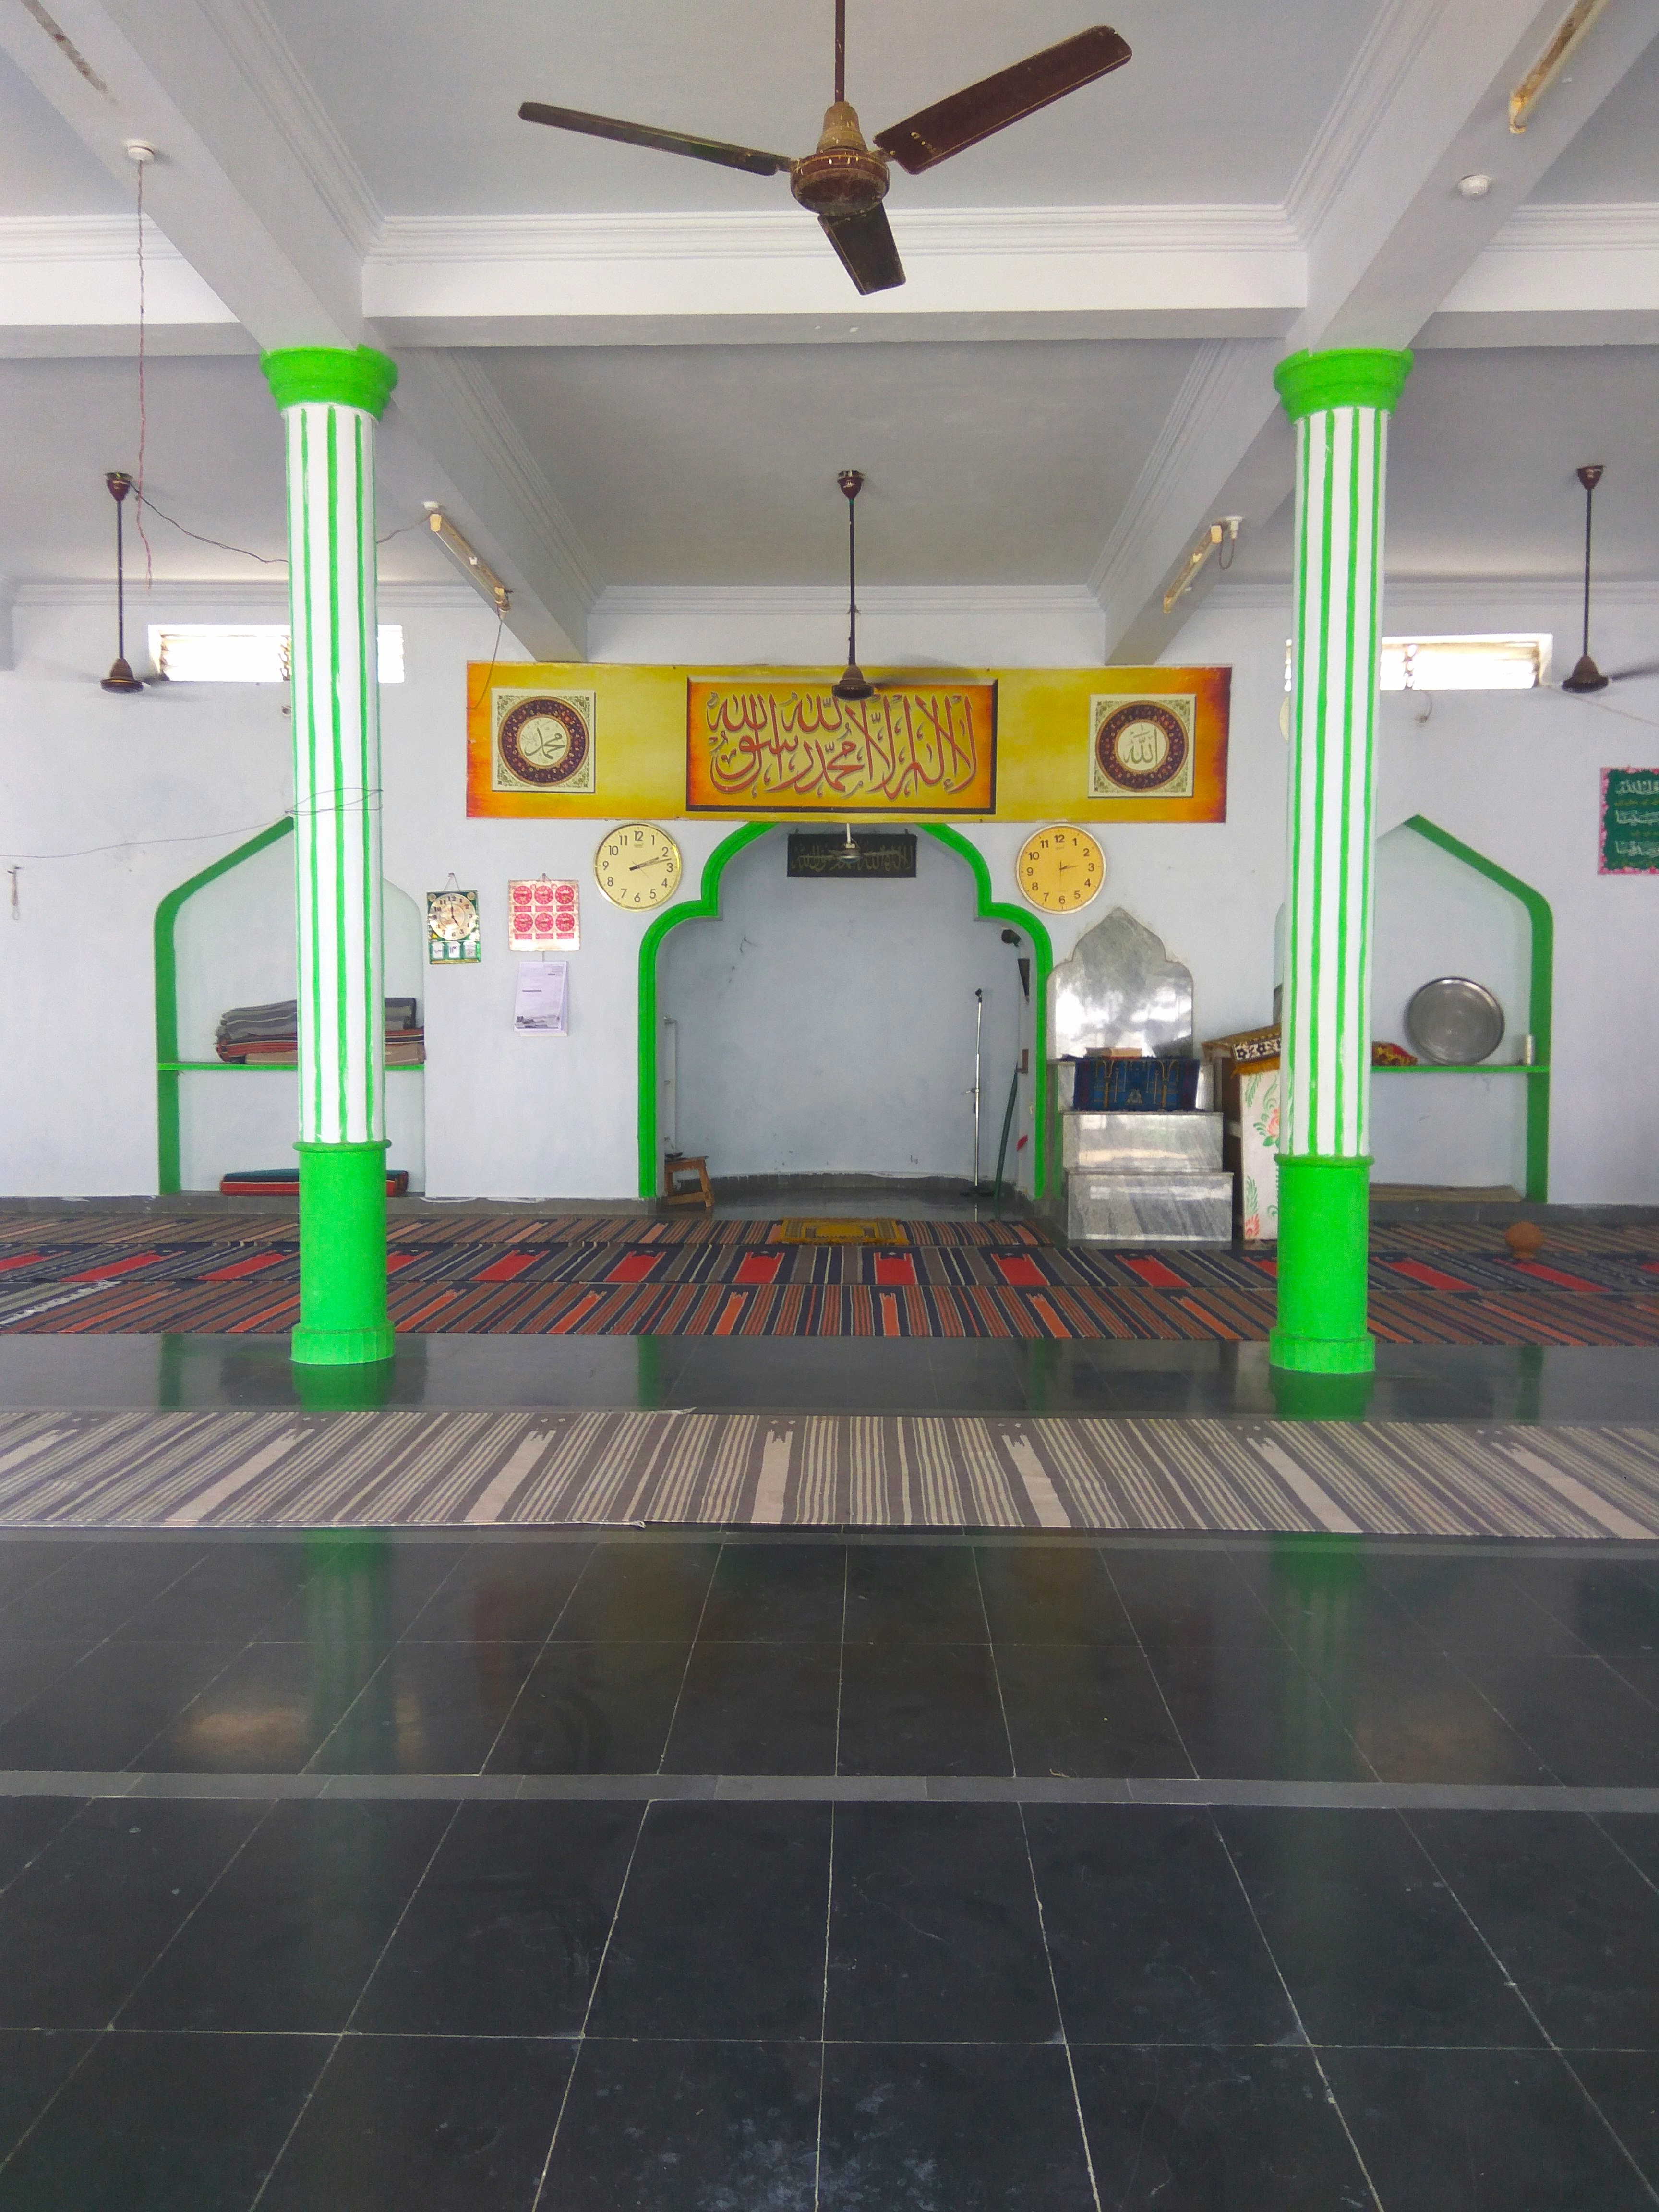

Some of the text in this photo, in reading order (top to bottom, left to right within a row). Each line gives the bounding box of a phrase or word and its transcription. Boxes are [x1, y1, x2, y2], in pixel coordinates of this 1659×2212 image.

[915, 694, 978, 793] لا
[619, 835, 627, 845] 11
[634, 831, 643, 841] 12
[651, 835, 654, 845] 1
[1054, 834, 1065, 843] 12
[1040, 840, 1048, 848] 11
[1073, 837, 1077, 846] 1
[608, 845, 618, 855] 10
[662, 847, 668, 857] 2
[1083, 848, 1090, 857] 2
[1028, 852, 1039, 860] 10
[602, 861, 609, 870] 9
[666, 862, 673, 872] 3
[1088, 863, 1094, 872] 3
[1027, 867, 1034, 876] 9
[607, 877, 613, 886] 8
[661, 878, 667, 888] 4
[1032, 882, 1038, 890] 8
[1084, 878, 1091, 887] 4
[621, 889, 627, 898] 7
[634, 892, 640, 902] 6
[650, 889, 656, 899] 5
[1044, 892, 1049, 902] 7
[1074, 890, 1081, 899] 5
[1059, 896, 1065, 904] 6
